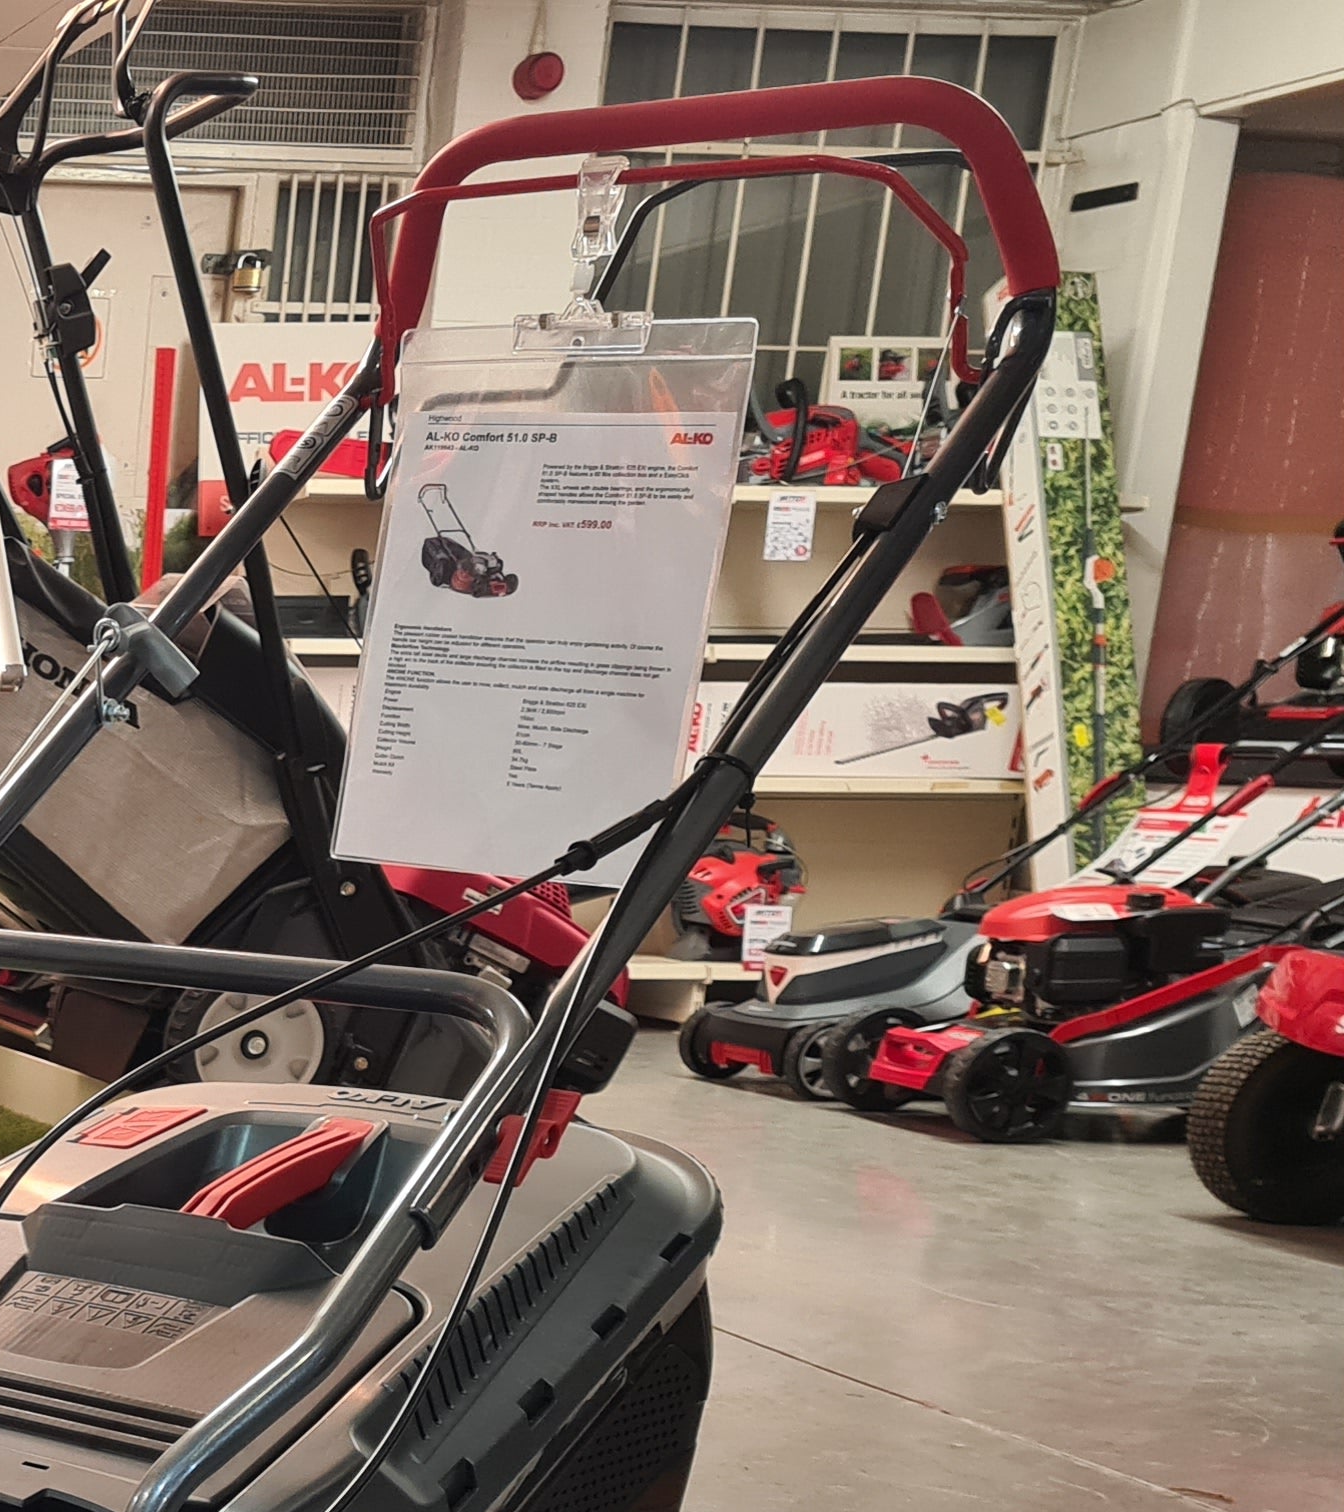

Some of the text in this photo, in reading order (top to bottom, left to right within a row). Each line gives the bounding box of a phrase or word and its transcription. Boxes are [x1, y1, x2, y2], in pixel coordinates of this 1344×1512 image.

[229, 363, 362, 403] AL-K
[841, 391, 847, 399] A
[849, 391, 878, 400] tractor
[881, 391, 894, 400] for
[428, 414, 462, 422] Highwood
[426, 432, 558, 443] AL-KO Comfort 51.0 SP-B
[670, 432, 714, 446] AL-KO
[576, 520, 612, 530] £599.00
